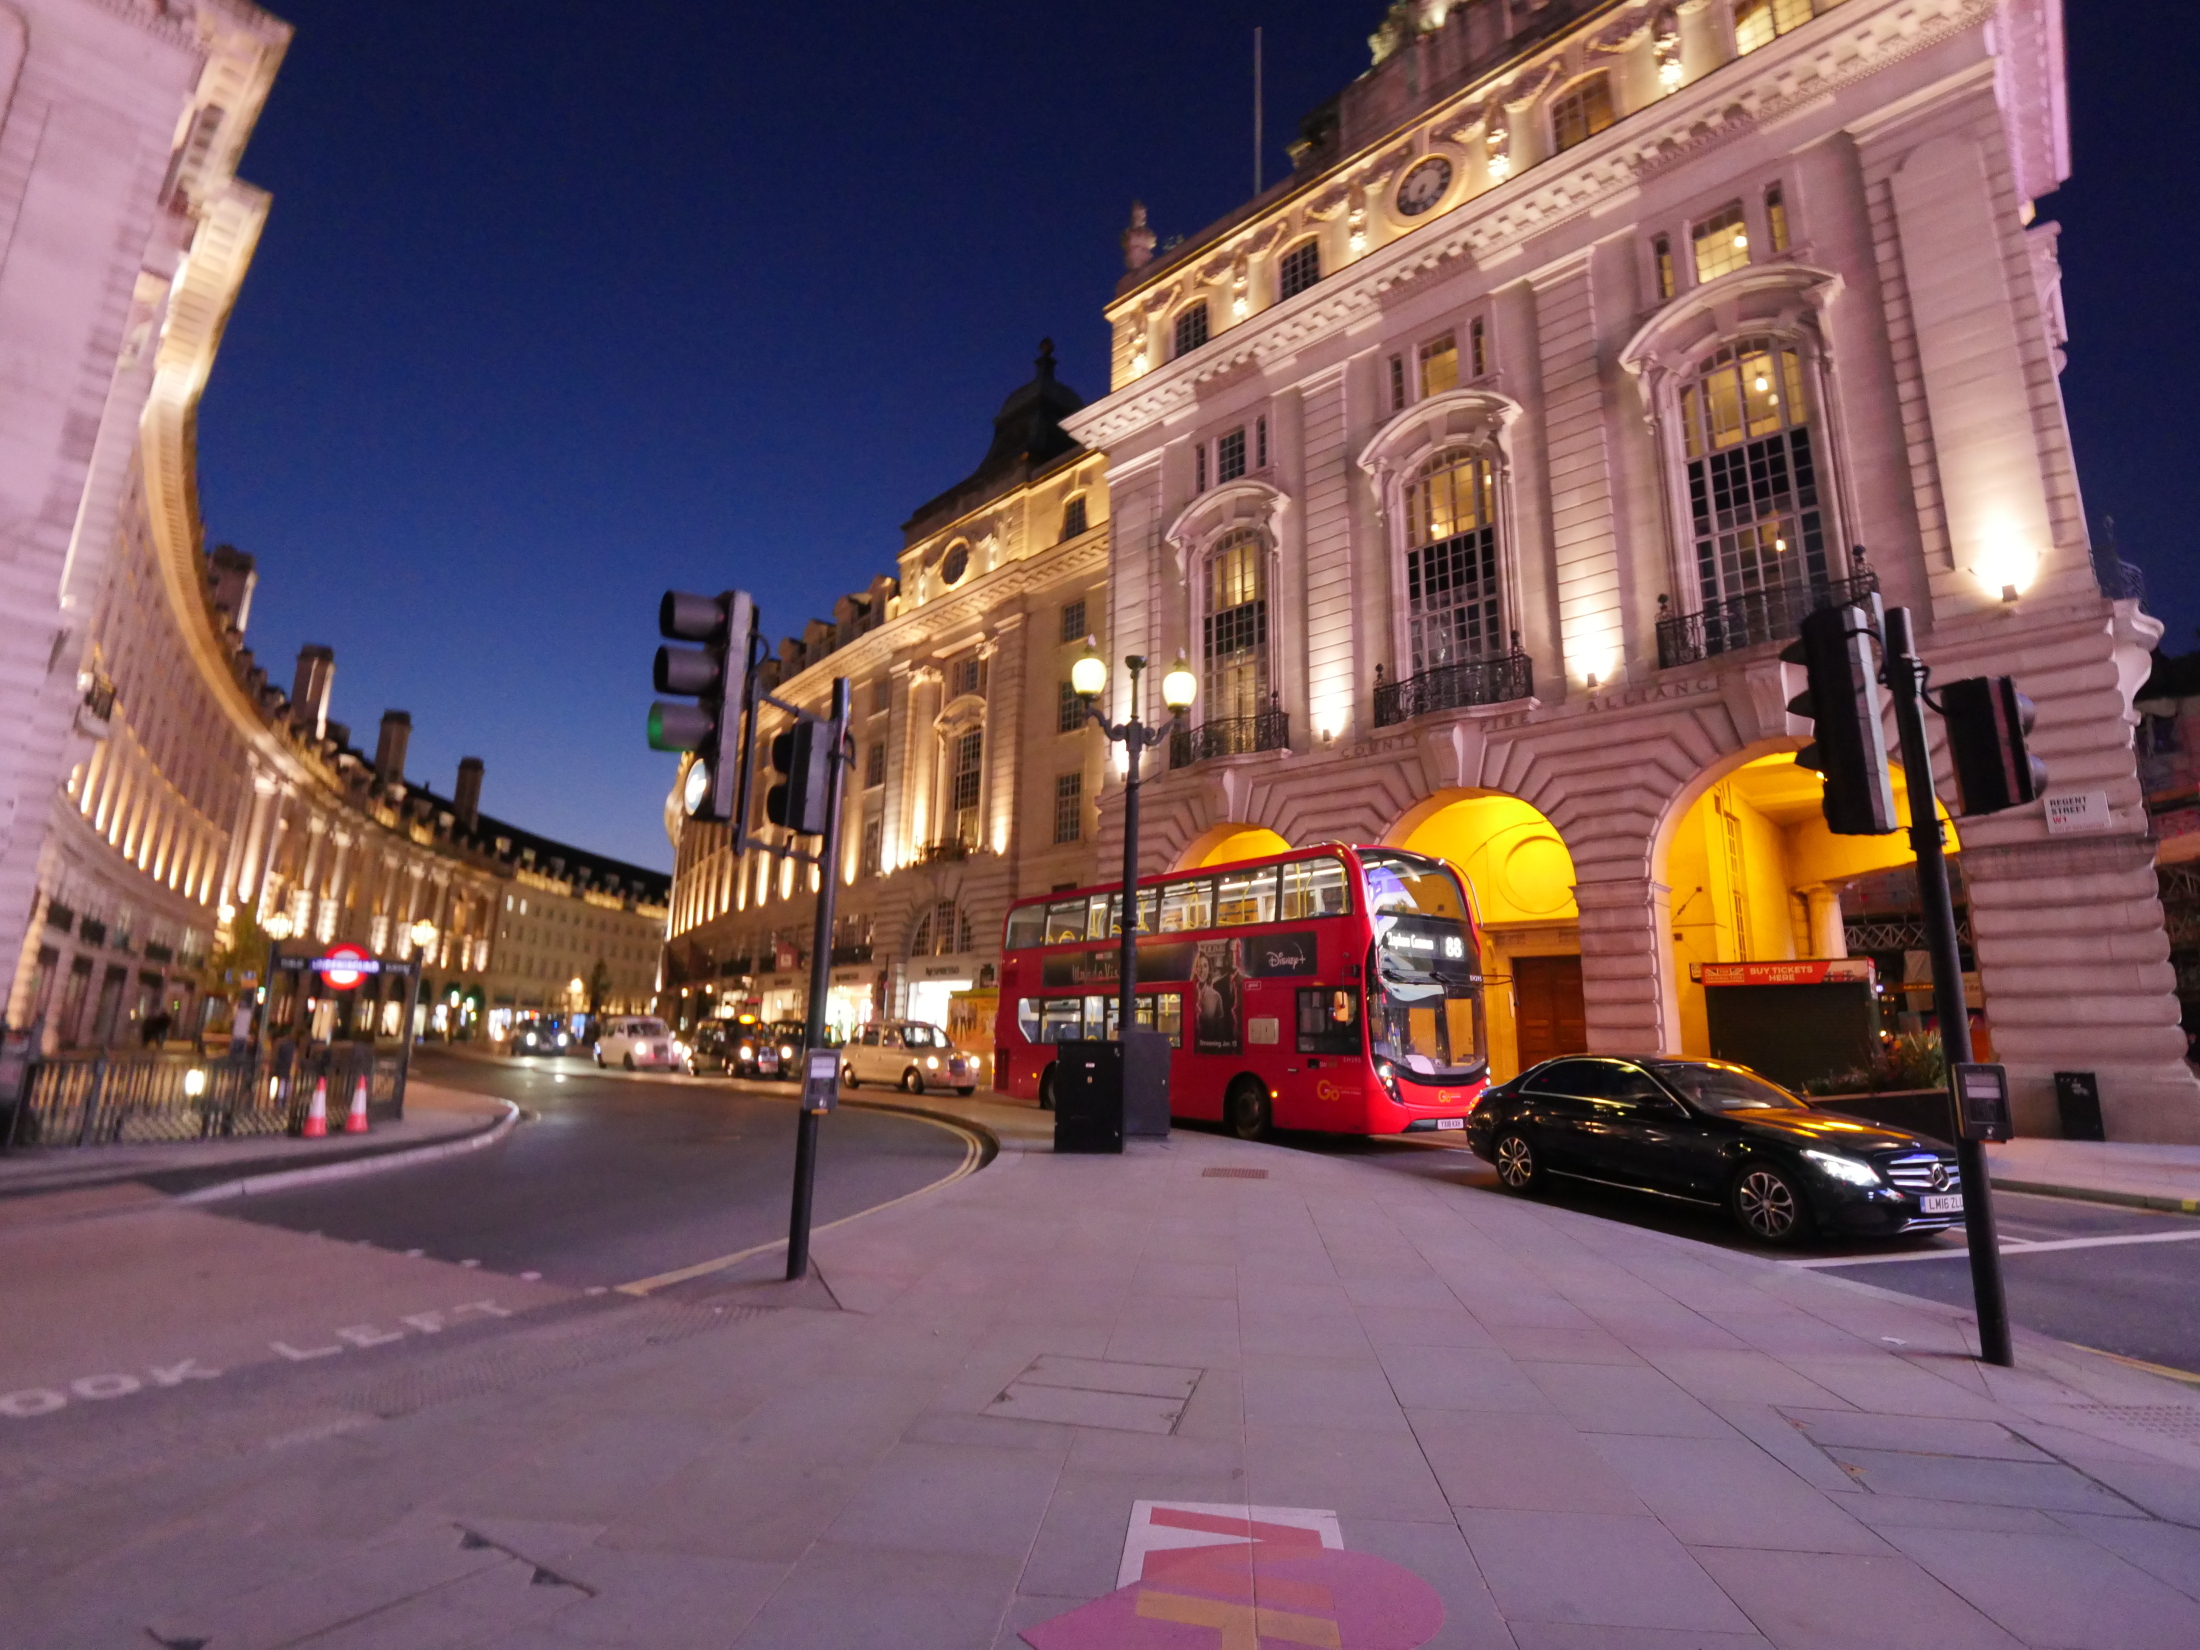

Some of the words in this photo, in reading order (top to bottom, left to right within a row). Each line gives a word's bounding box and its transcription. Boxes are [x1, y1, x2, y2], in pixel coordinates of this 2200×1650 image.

[1586, 674, 1728, 712] ALLIANCE
[1341, 733, 1422, 759] COUNTY
[1479, 714, 1529, 732] FIRE
[2050, 796, 2086, 807] REGENT
[2051, 805, 2086, 815] STREET
[2053, 816, 2067, 824] W1
[1445, 936, 1463, 958] 88
[1266, 947, 1306, 970] Disney+
[1072, 962, 1120, 984] WandaVis
[1750, 966, 1770, 976] BUY
[1772, 965, 1813, 975] TICKETS
[1769, 973, 1795, 982] HERE
[1317, 1079, 1340, 1101] Go
[1438, 1090, 1451, 1103] Go
[1929, 1198, 1950, 1209] LM16
[269, 1299, 512, 1361] LEFT
